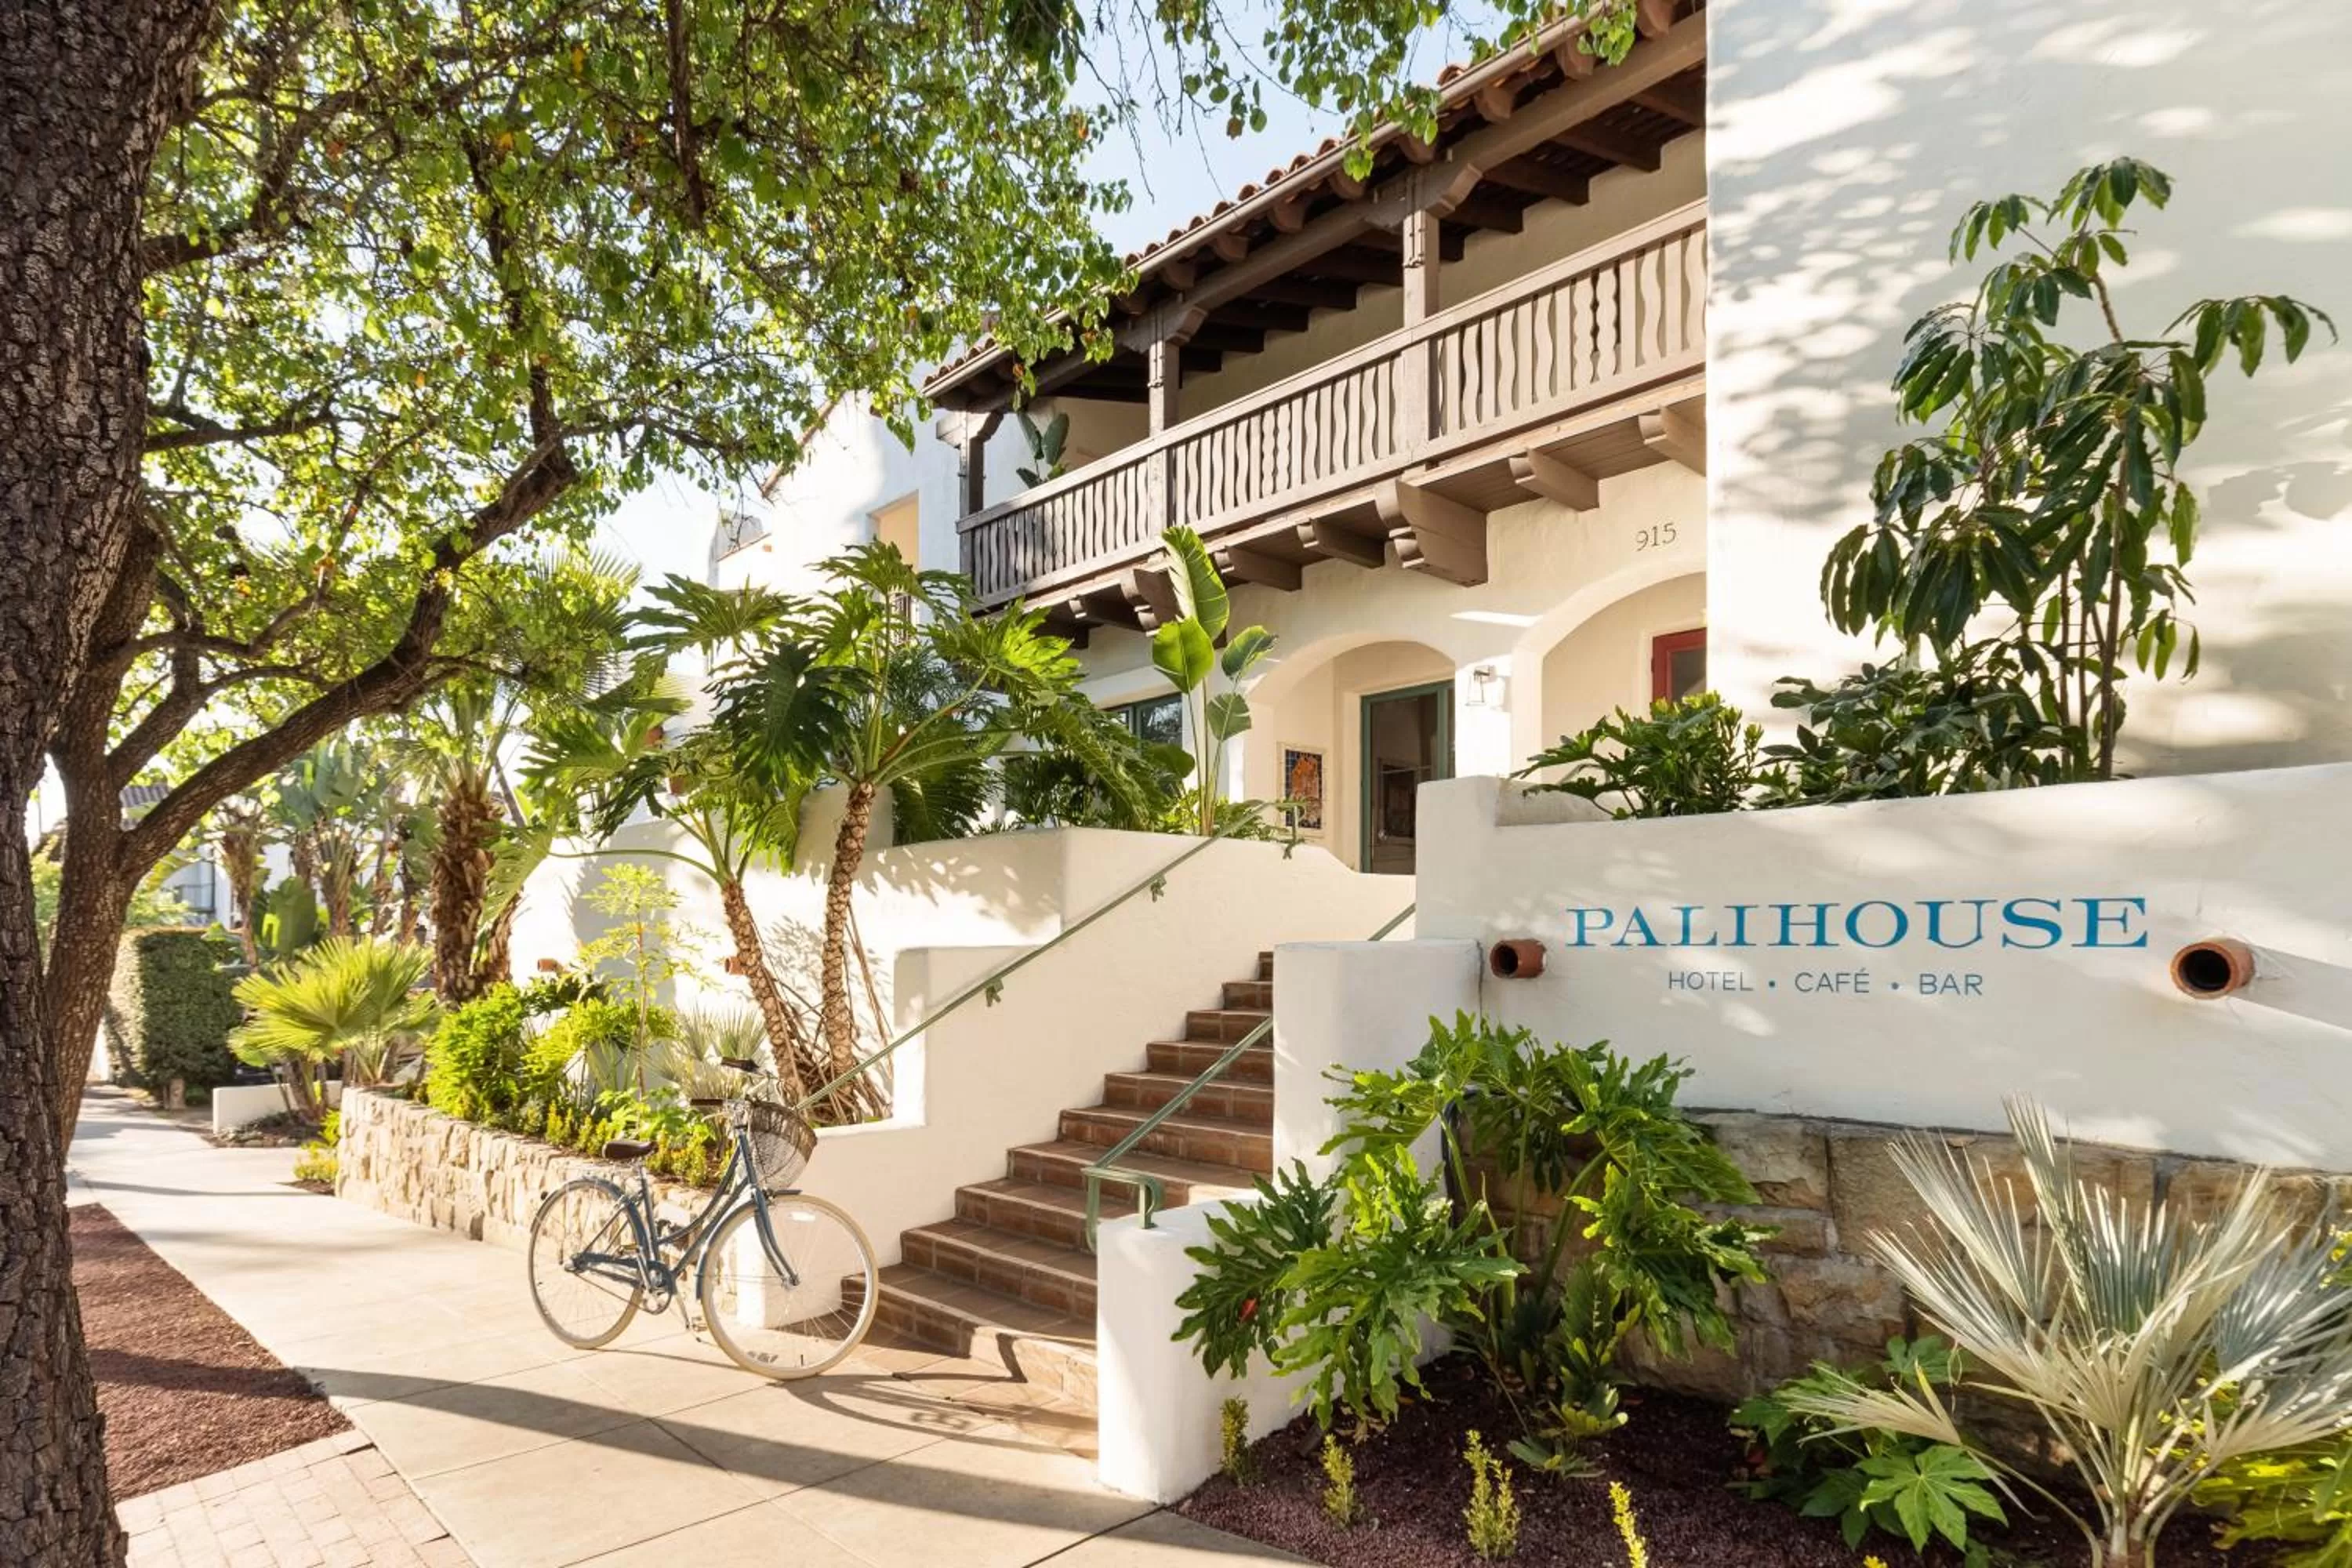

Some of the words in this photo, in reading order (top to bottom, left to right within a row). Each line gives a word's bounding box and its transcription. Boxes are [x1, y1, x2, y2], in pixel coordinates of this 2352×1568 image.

[1636, 522, 1676, 551] 915
[1566, 897, 2149, 949] PALIHOUSE
[1668, 971, 1754, 992] HOTEL
[1795, 967, 1870, 993] CAFÉ
[1919, 973, 1983, 996] BAR
